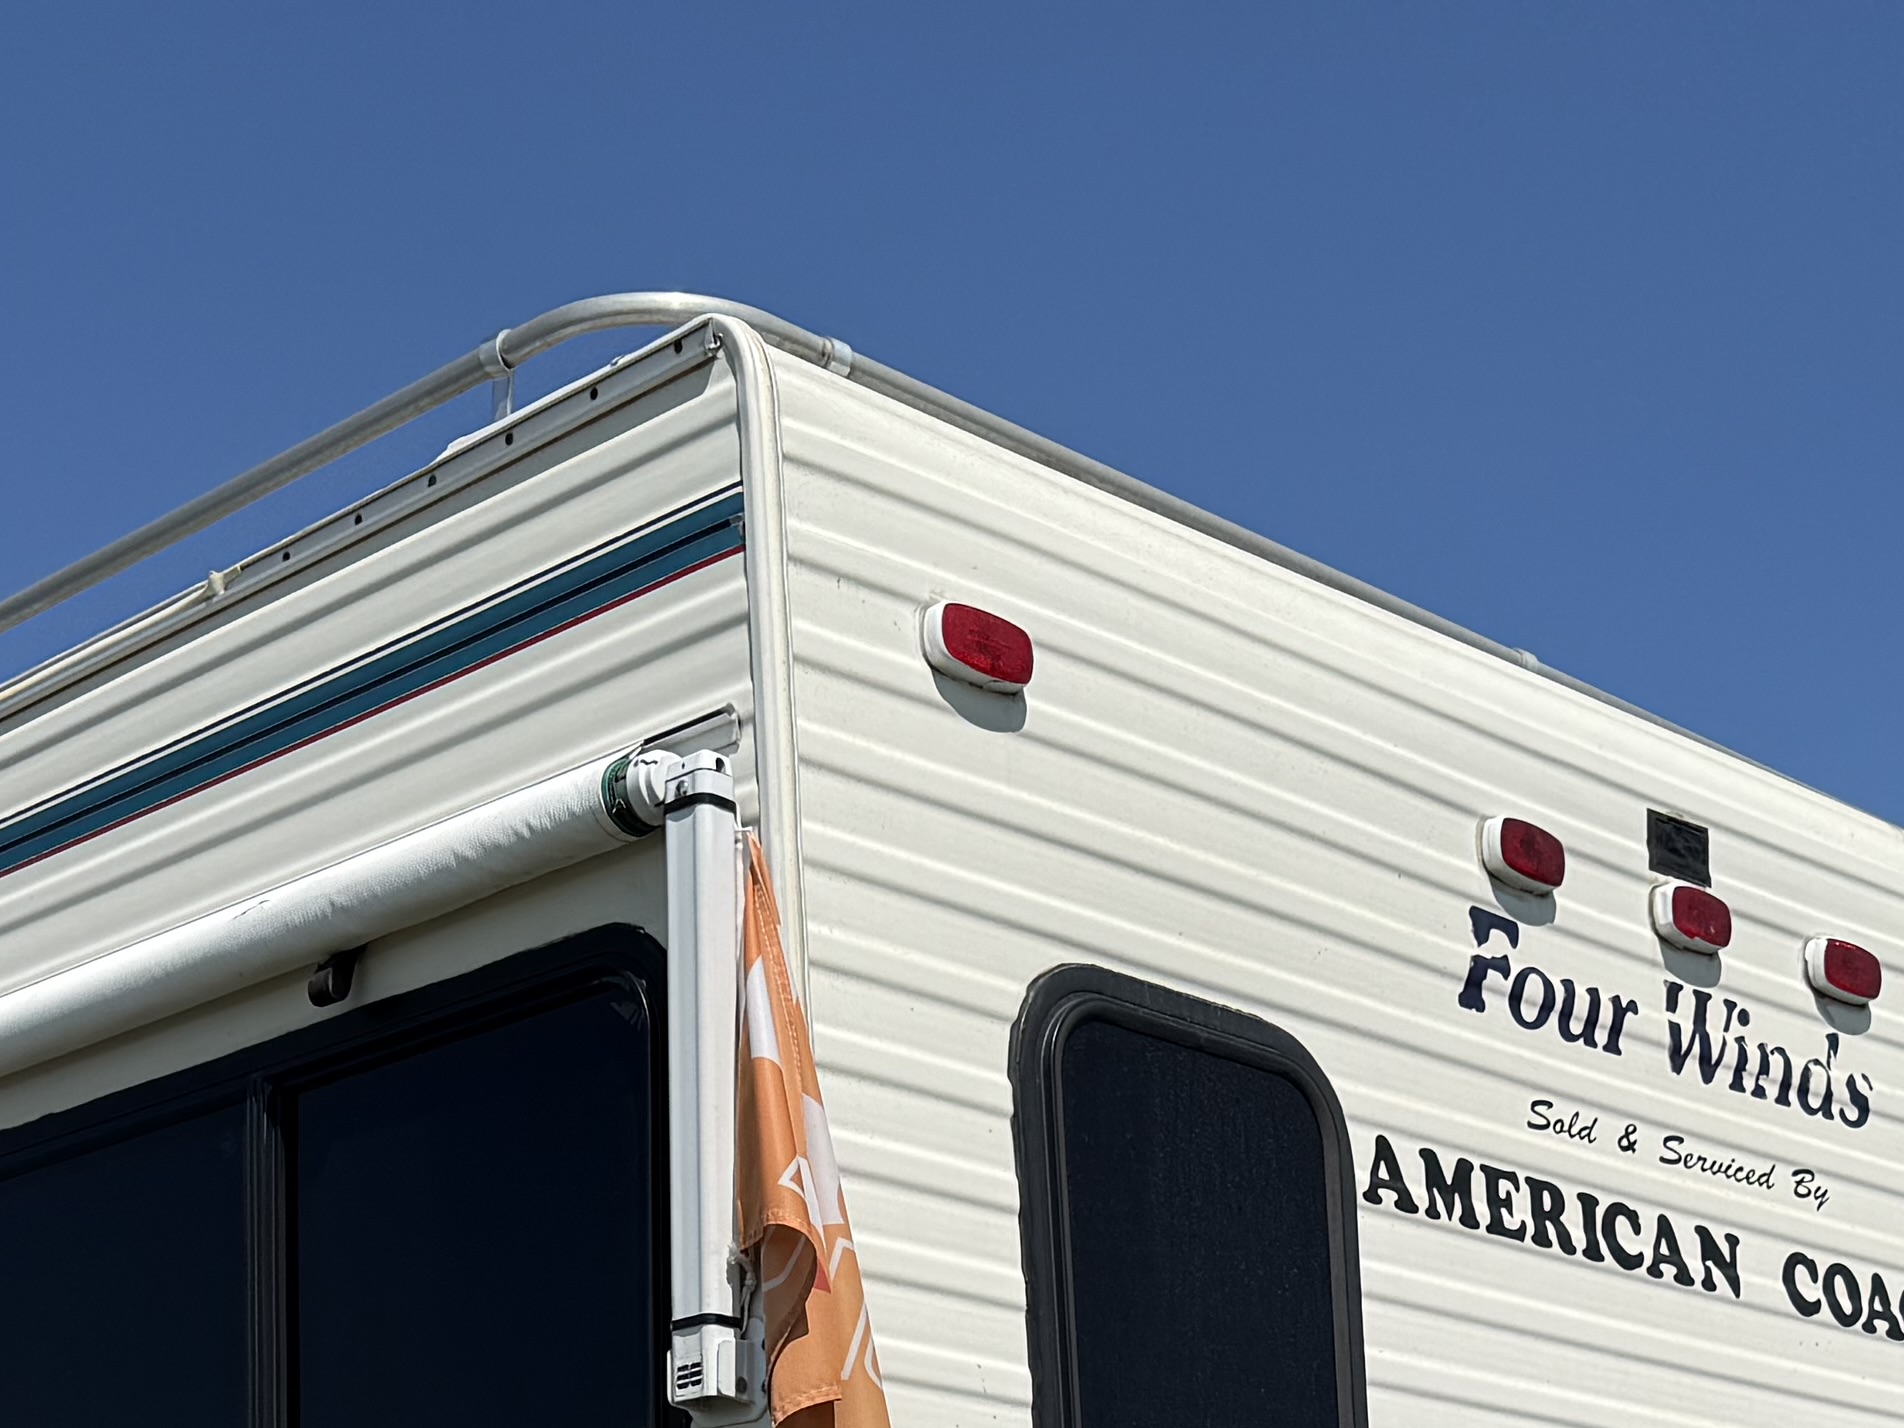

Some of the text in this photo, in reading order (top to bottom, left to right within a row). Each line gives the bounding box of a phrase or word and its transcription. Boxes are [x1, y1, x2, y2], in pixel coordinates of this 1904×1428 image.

[1457, 904, 1875, 1130] Four Winds
[1361, 1133, 1742, 1300] AMERICAN
[1526, 1099, 1831, 1210] Sold & Serviced By
